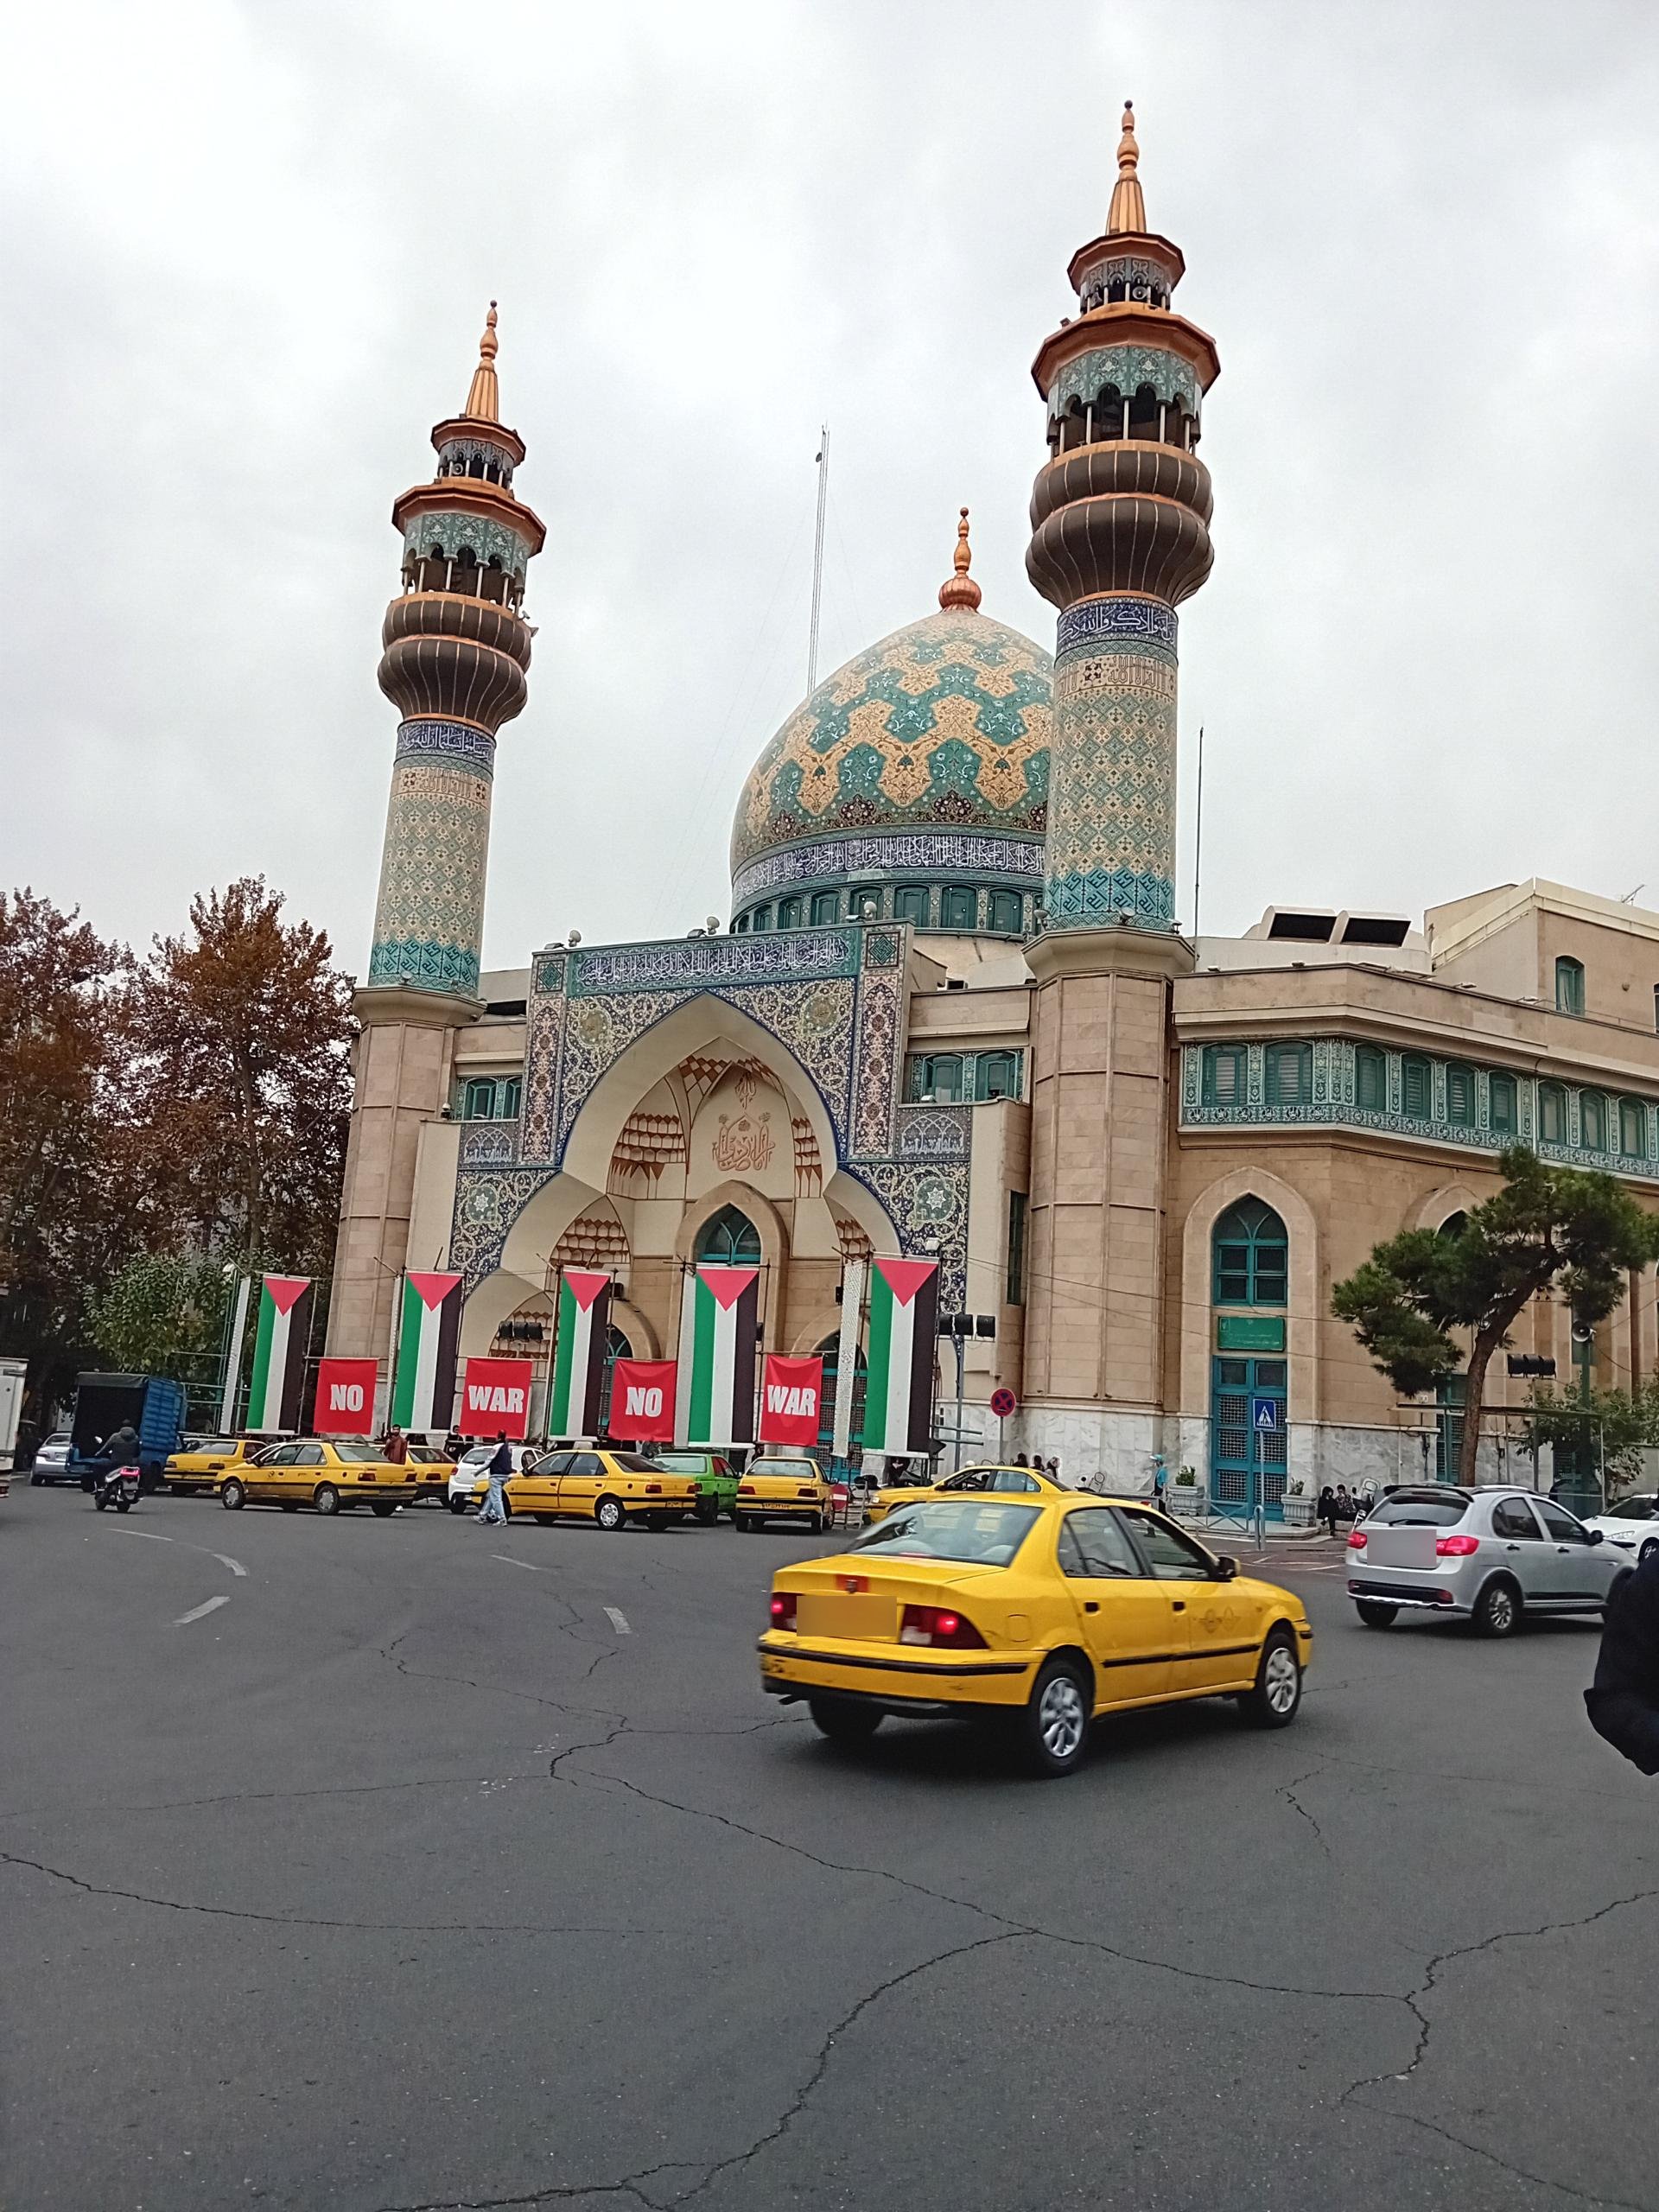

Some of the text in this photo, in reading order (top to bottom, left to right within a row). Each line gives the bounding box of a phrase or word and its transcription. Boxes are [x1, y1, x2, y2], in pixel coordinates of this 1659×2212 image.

[330, 1384, 363, 1411] NO
[468, 1385, 524, 1413] WAR
[626, 1387, 662, 1417] NO
[767, 1385, 816, 1416] WAR
